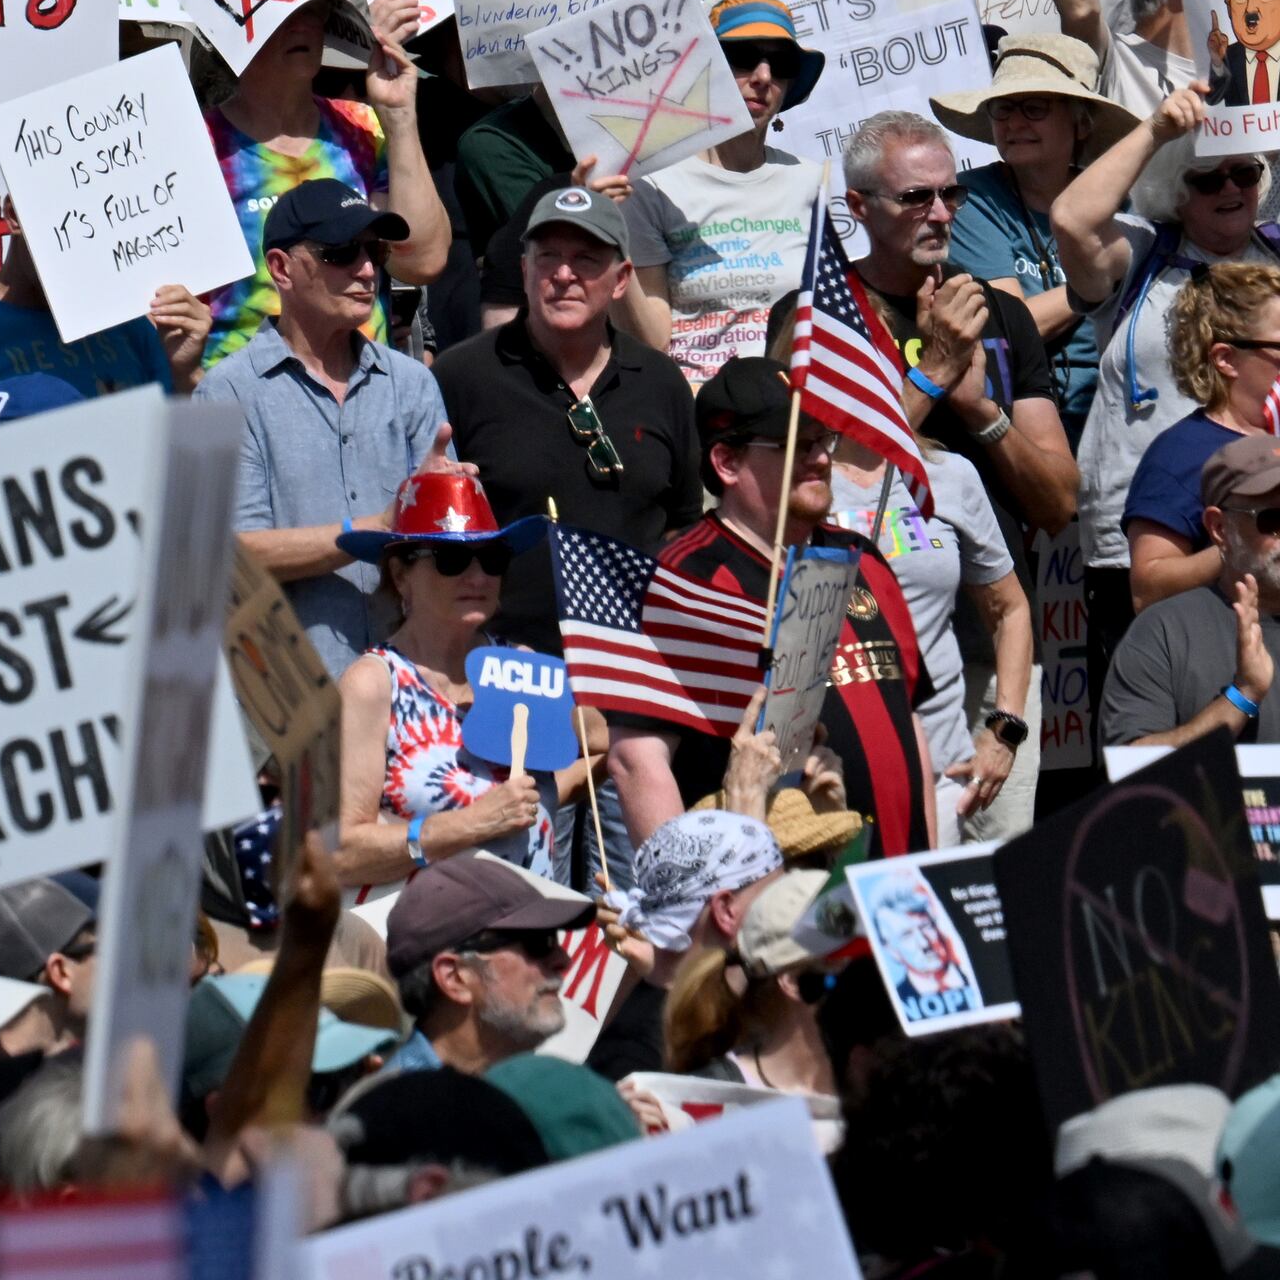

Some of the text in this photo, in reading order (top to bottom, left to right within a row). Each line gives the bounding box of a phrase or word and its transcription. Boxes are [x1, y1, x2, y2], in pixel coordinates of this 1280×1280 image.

[15, 118, 62, 167] THIS
[70, 130, 146, 189] IS SICK!
[54, 171, 177, 252] IT'S FULL OF
[112, 215, 185, 272] MAGATS!
[478, 655, 564, 699] ACLU
[602, 1171, 758, 1244] Want
